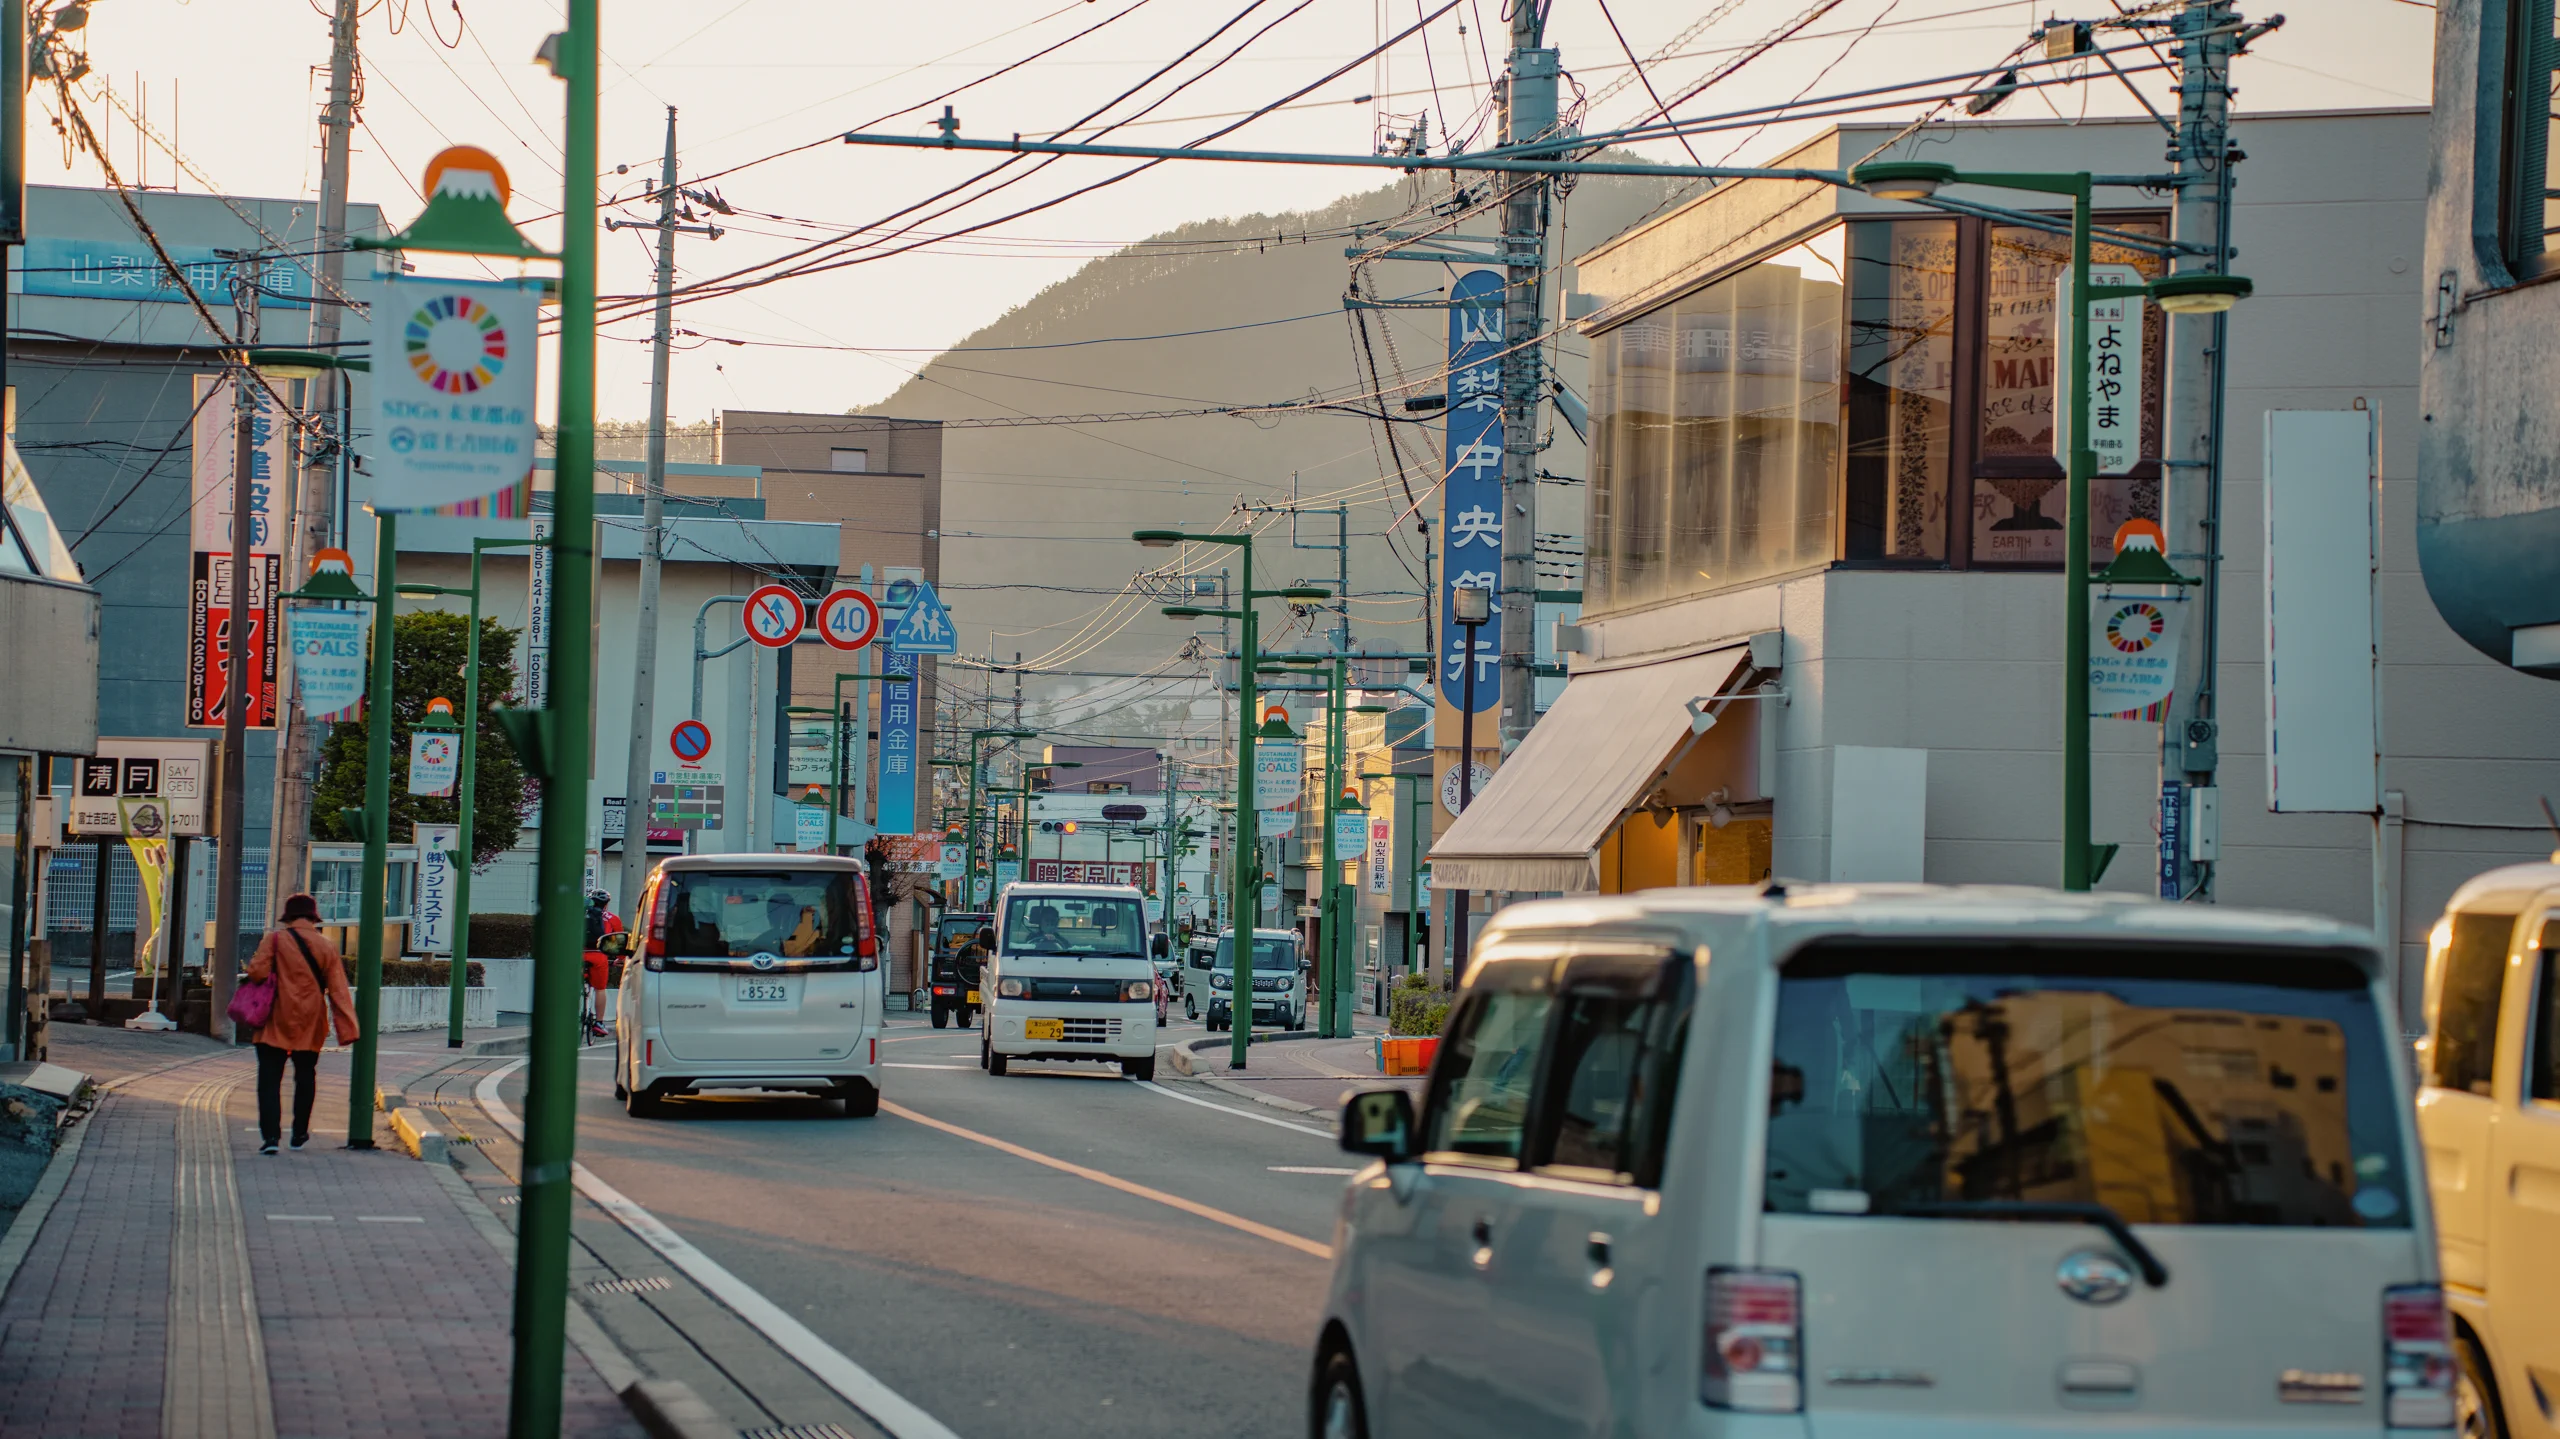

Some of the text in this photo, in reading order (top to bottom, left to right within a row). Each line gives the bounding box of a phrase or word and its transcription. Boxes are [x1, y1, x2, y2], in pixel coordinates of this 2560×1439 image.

[2096, 325, 2122, 429] よねやま
[382, 399, 440, 419] SDGs
[831, 606, 865, 634] 40
[261, 558, 278, 721] Real Educational Group WILL
[293, 639, 359, 657] GOALS
[192, 590, 207, 720] 0555(22)8160
[168, 766, 190, 777] SAY
[668, 772, 722, 780] 市営駐車場案内
[1258, 763, 1297, 773] GOALS
[88, 765, 153, 790] 清月
[167, 780, 195, 792] GETS
[1447, 787, 1453, 795] 9
[1450, 796, 1457, 804] 8
[78, 812, 117, 825] 富士吉田店
[1038, 865, 1129, 883] 贈答品に
[1374, 841, 1386, 889] 山梨日日新聞
[2165, 864, 2173, 877] 6
[423, 851, 445, 947] (株)フジエステート
[748, 986, 785, 999] 85-29
